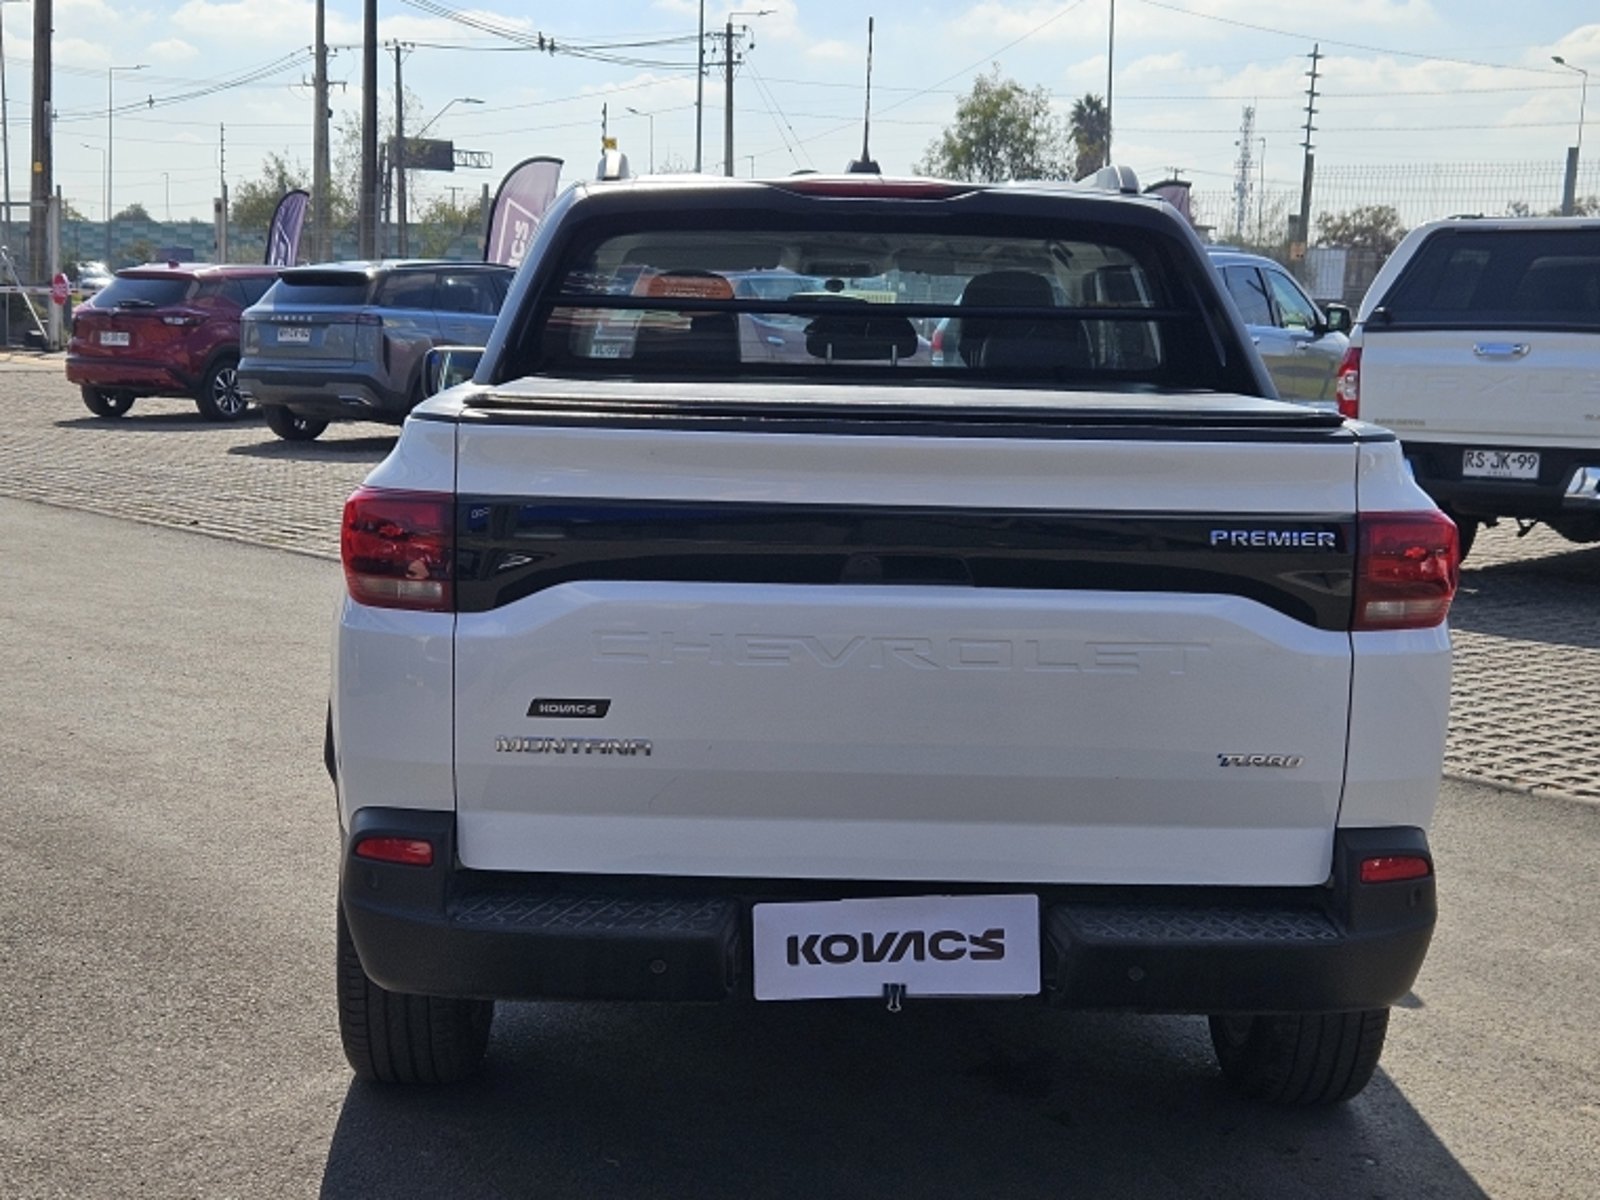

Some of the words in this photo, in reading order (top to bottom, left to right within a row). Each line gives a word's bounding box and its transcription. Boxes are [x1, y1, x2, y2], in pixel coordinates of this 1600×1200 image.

[1210, 529, 1336, 547] PREMIER
[592, 630, 1212, 676] CHEVROLET
[539, 703, 598, 715] KOVACS
[495, 735, 652, 756] MONTANA
[786, 928, 1005, 966] KOVACS
